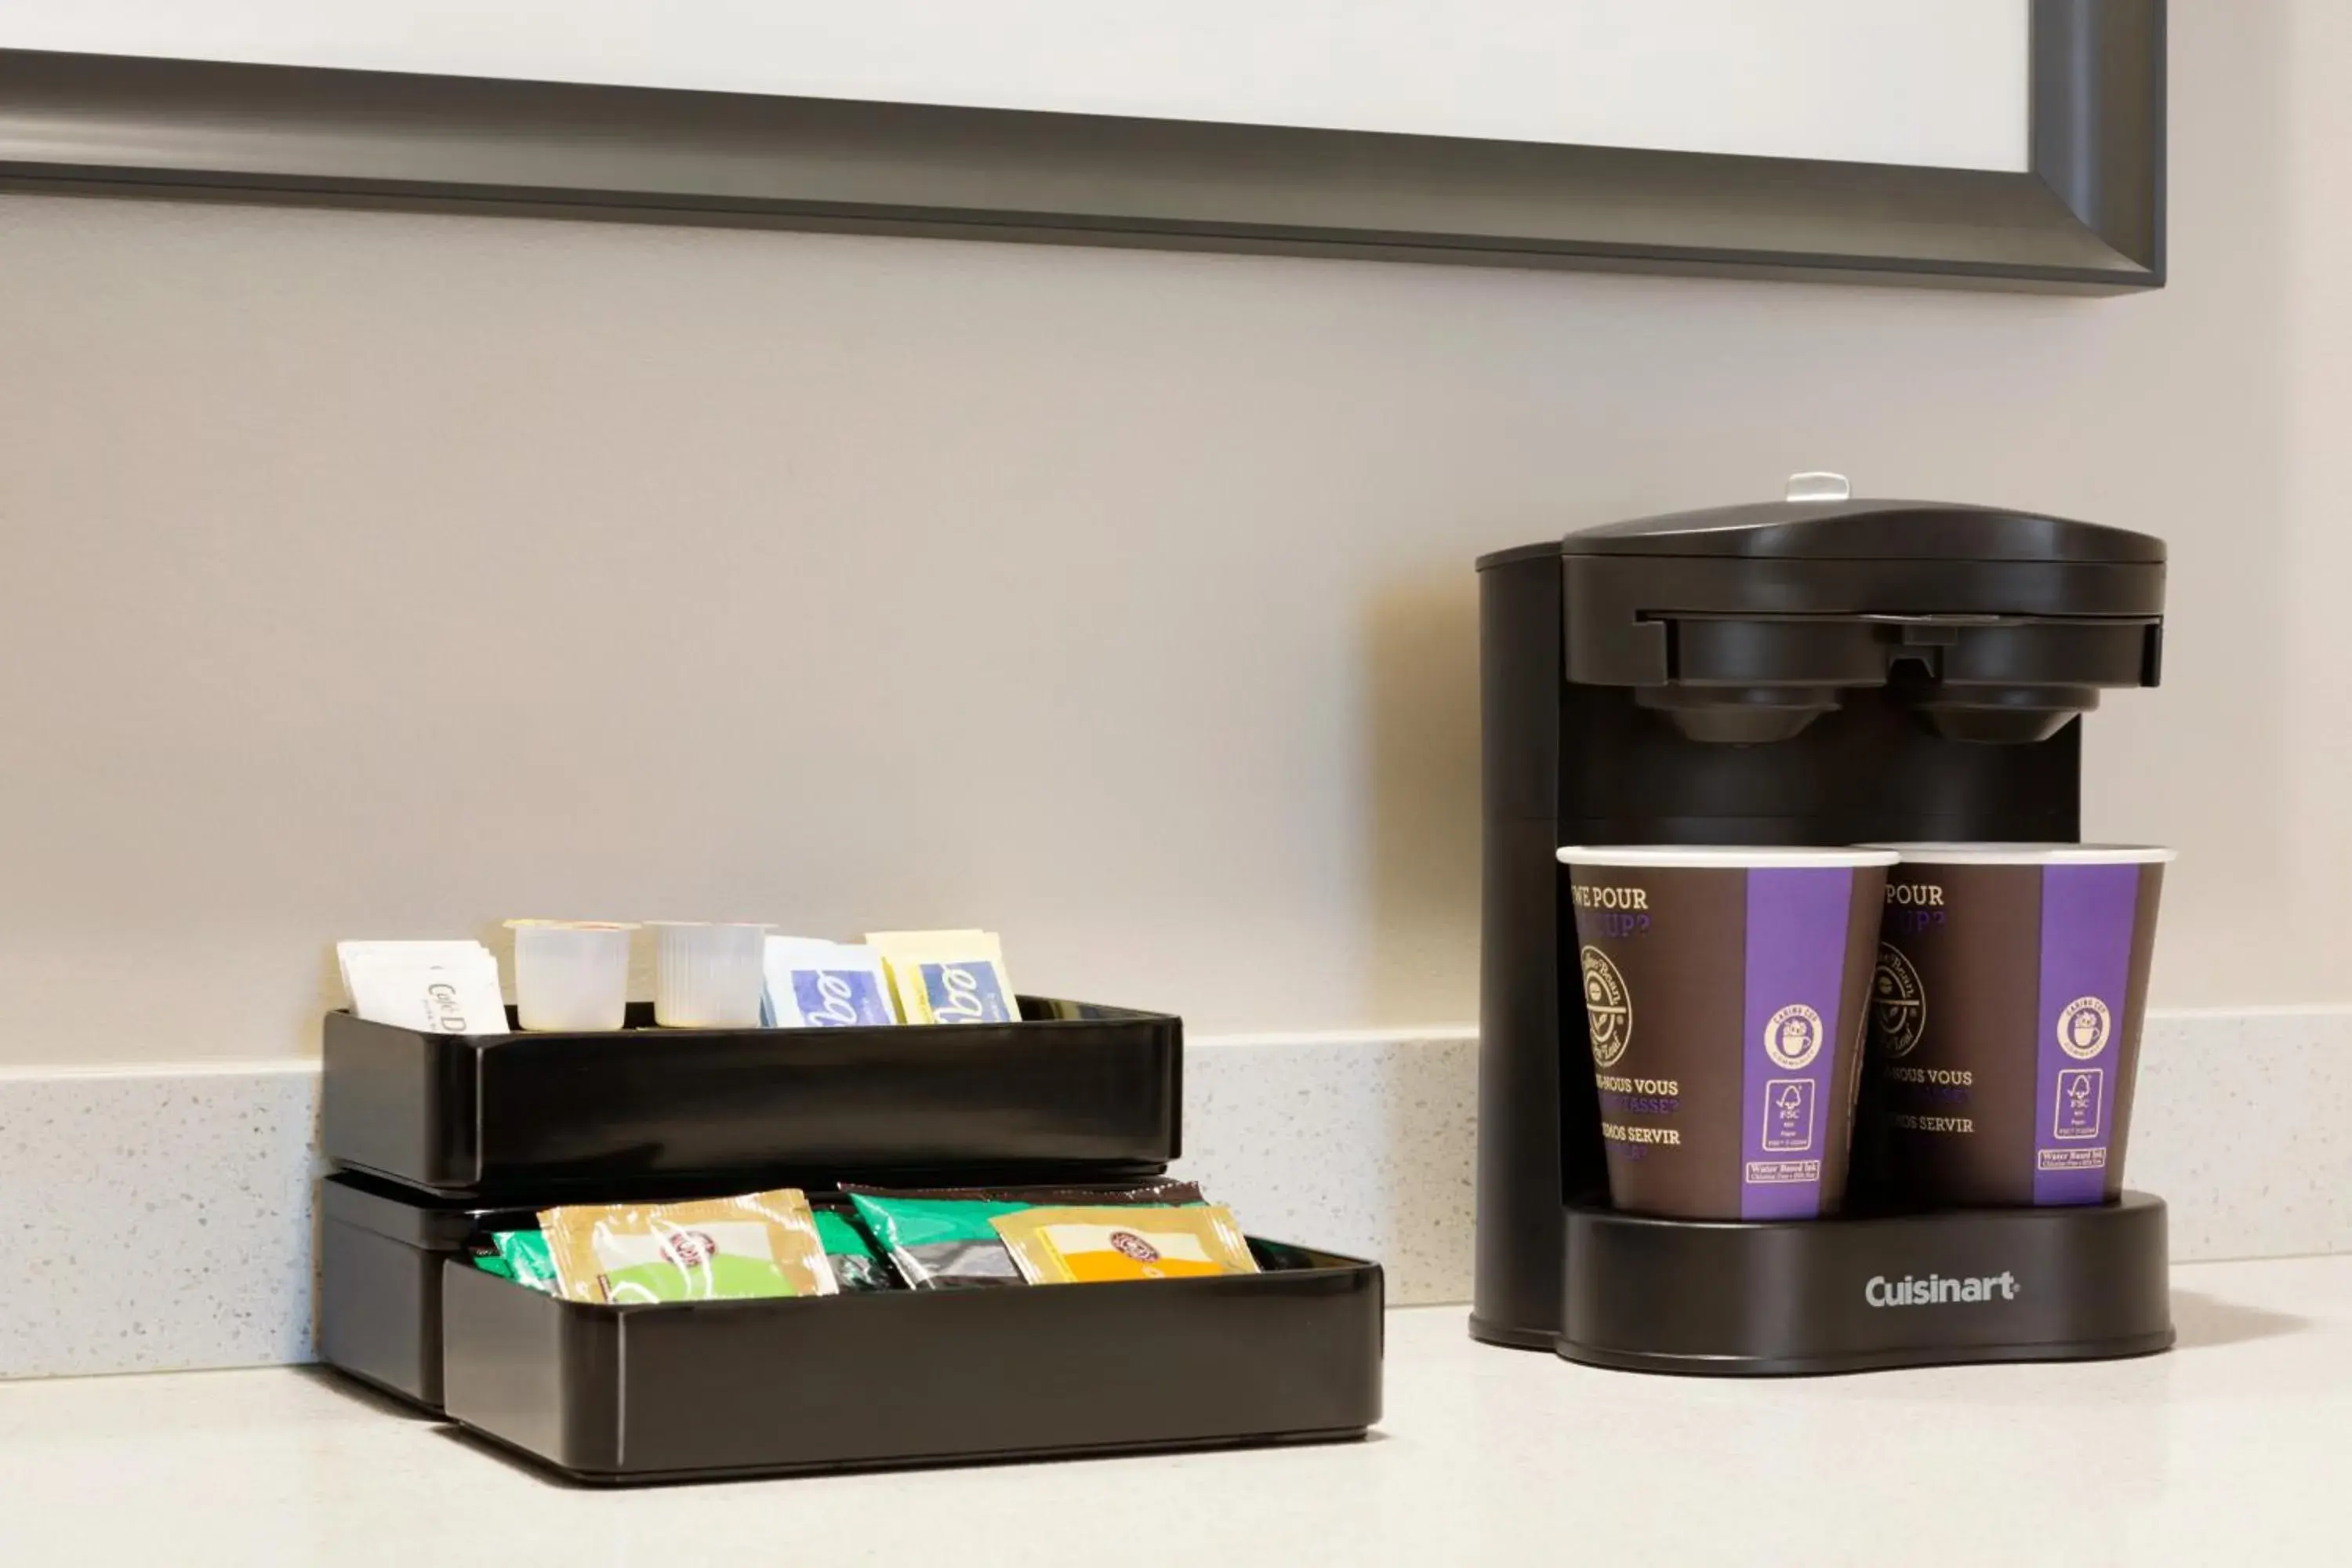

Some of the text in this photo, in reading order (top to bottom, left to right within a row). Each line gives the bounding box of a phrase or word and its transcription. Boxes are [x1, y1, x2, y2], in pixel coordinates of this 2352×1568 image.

[1592, 887, 1649, 909] POUR
[1886, 884, 1944, 906] POUR
[933, 964, 984, 1024] eq
[1634, 1079, 1679, 1096] VOUS
[1927, 1069, 1973, 1087] VOUS
[1919, 1115, 1974, 1133] SERVIR
[1628, 1127, 1681, 1145] SERVIR
[1865, 1270, 2014, 1308] Cuisinart
